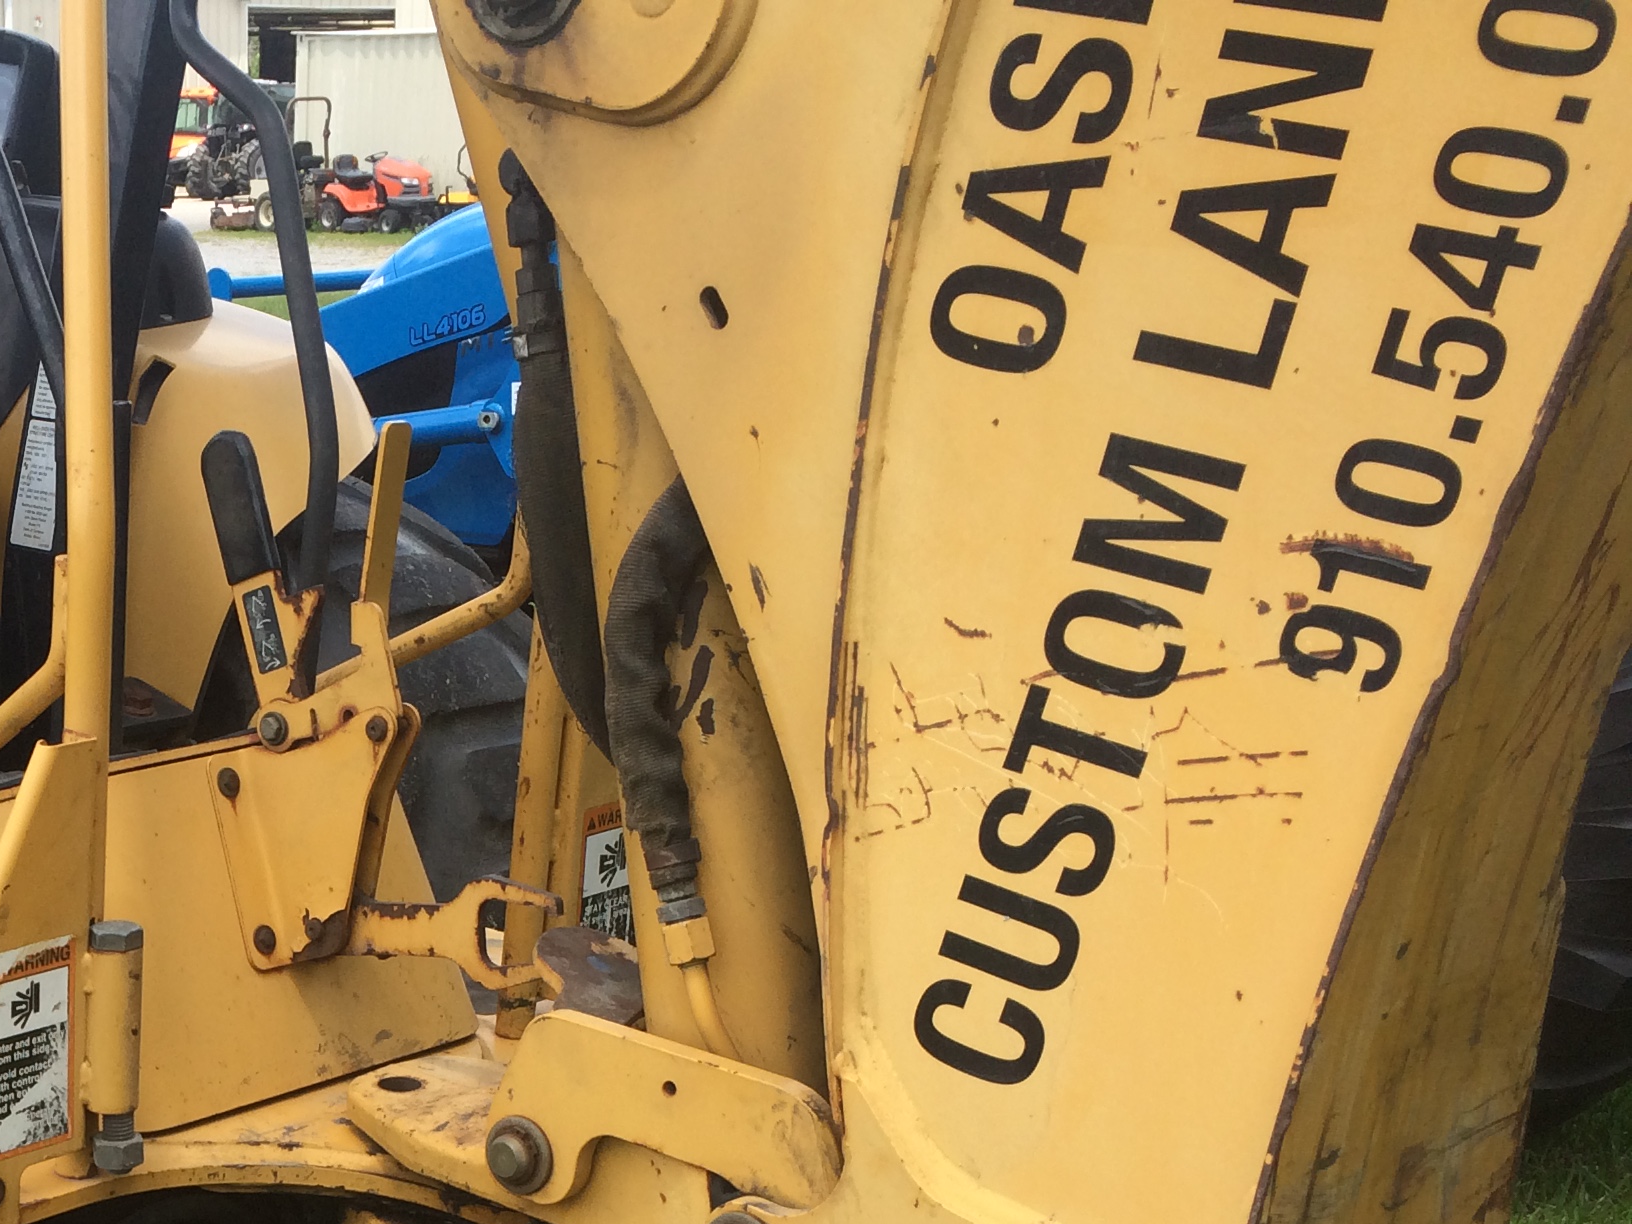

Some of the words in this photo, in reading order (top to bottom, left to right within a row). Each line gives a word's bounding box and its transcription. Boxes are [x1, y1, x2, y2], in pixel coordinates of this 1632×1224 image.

[409, 303, 486, 347] LL4106
[913, 433, 1247, 1086] CUSTOM
[8, 944, 70, 976] ARNING
[13, 1048, 30, 1061] this
[15, 1036, 30, 1050] and
[32, 1032, 47, 1045] exit
